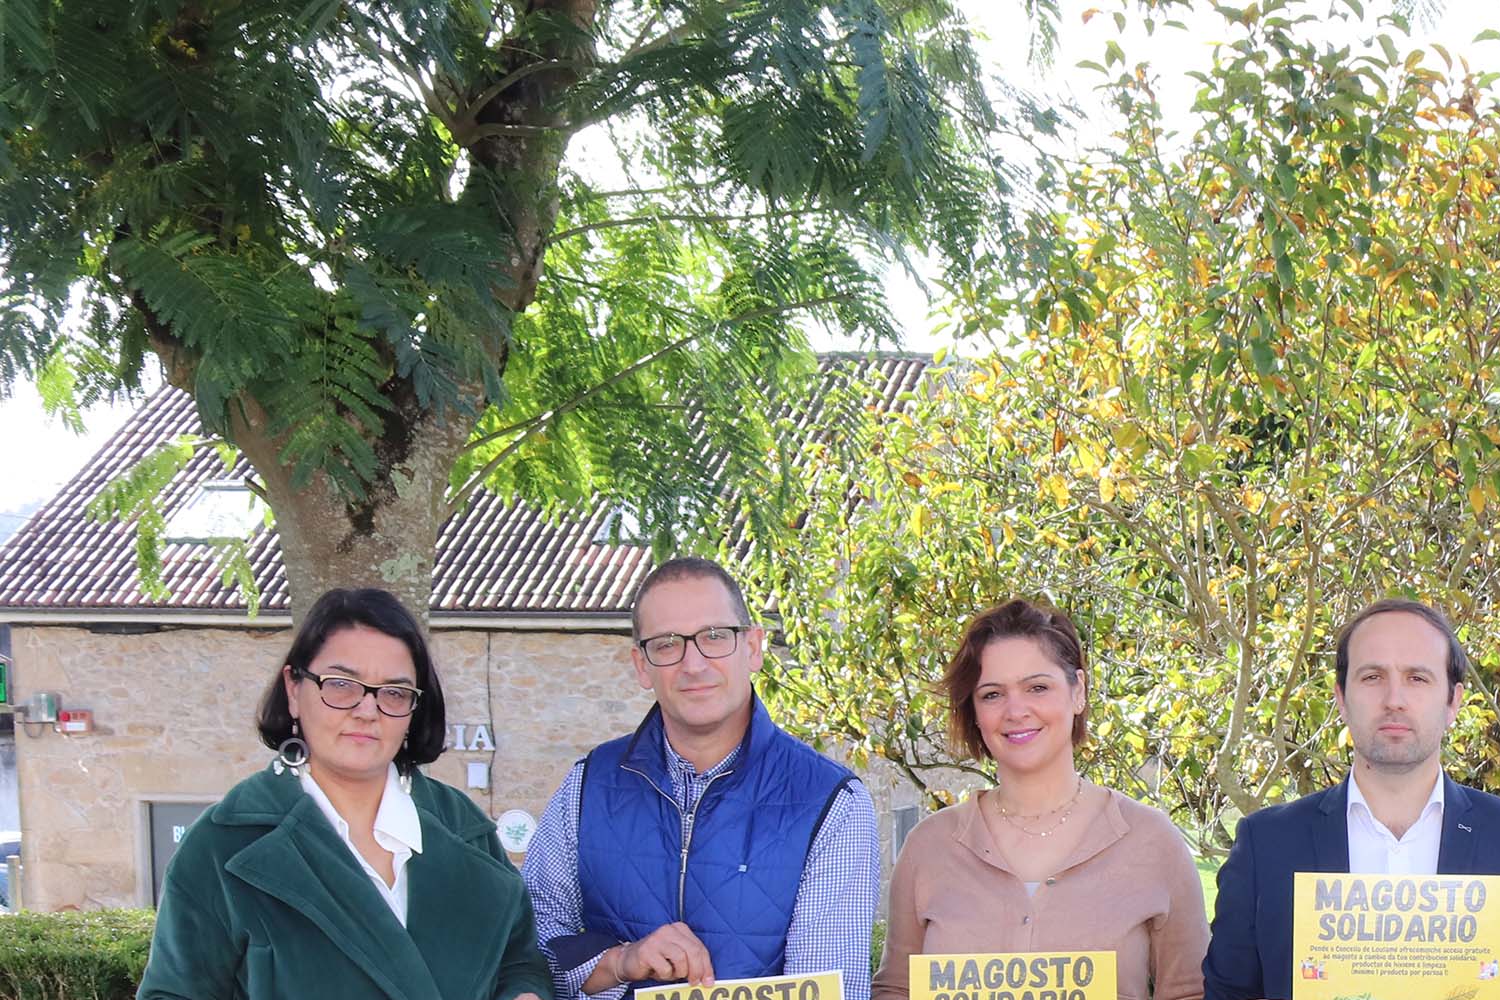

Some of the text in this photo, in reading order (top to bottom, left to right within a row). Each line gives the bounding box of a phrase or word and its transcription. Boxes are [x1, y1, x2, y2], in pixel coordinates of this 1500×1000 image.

[1315, 879, 1486, 913] MAGOSTO
[1318, 913, 1477, 942] SOLIDARIO
[929, 956, 1094, 991] MAGOSTO
